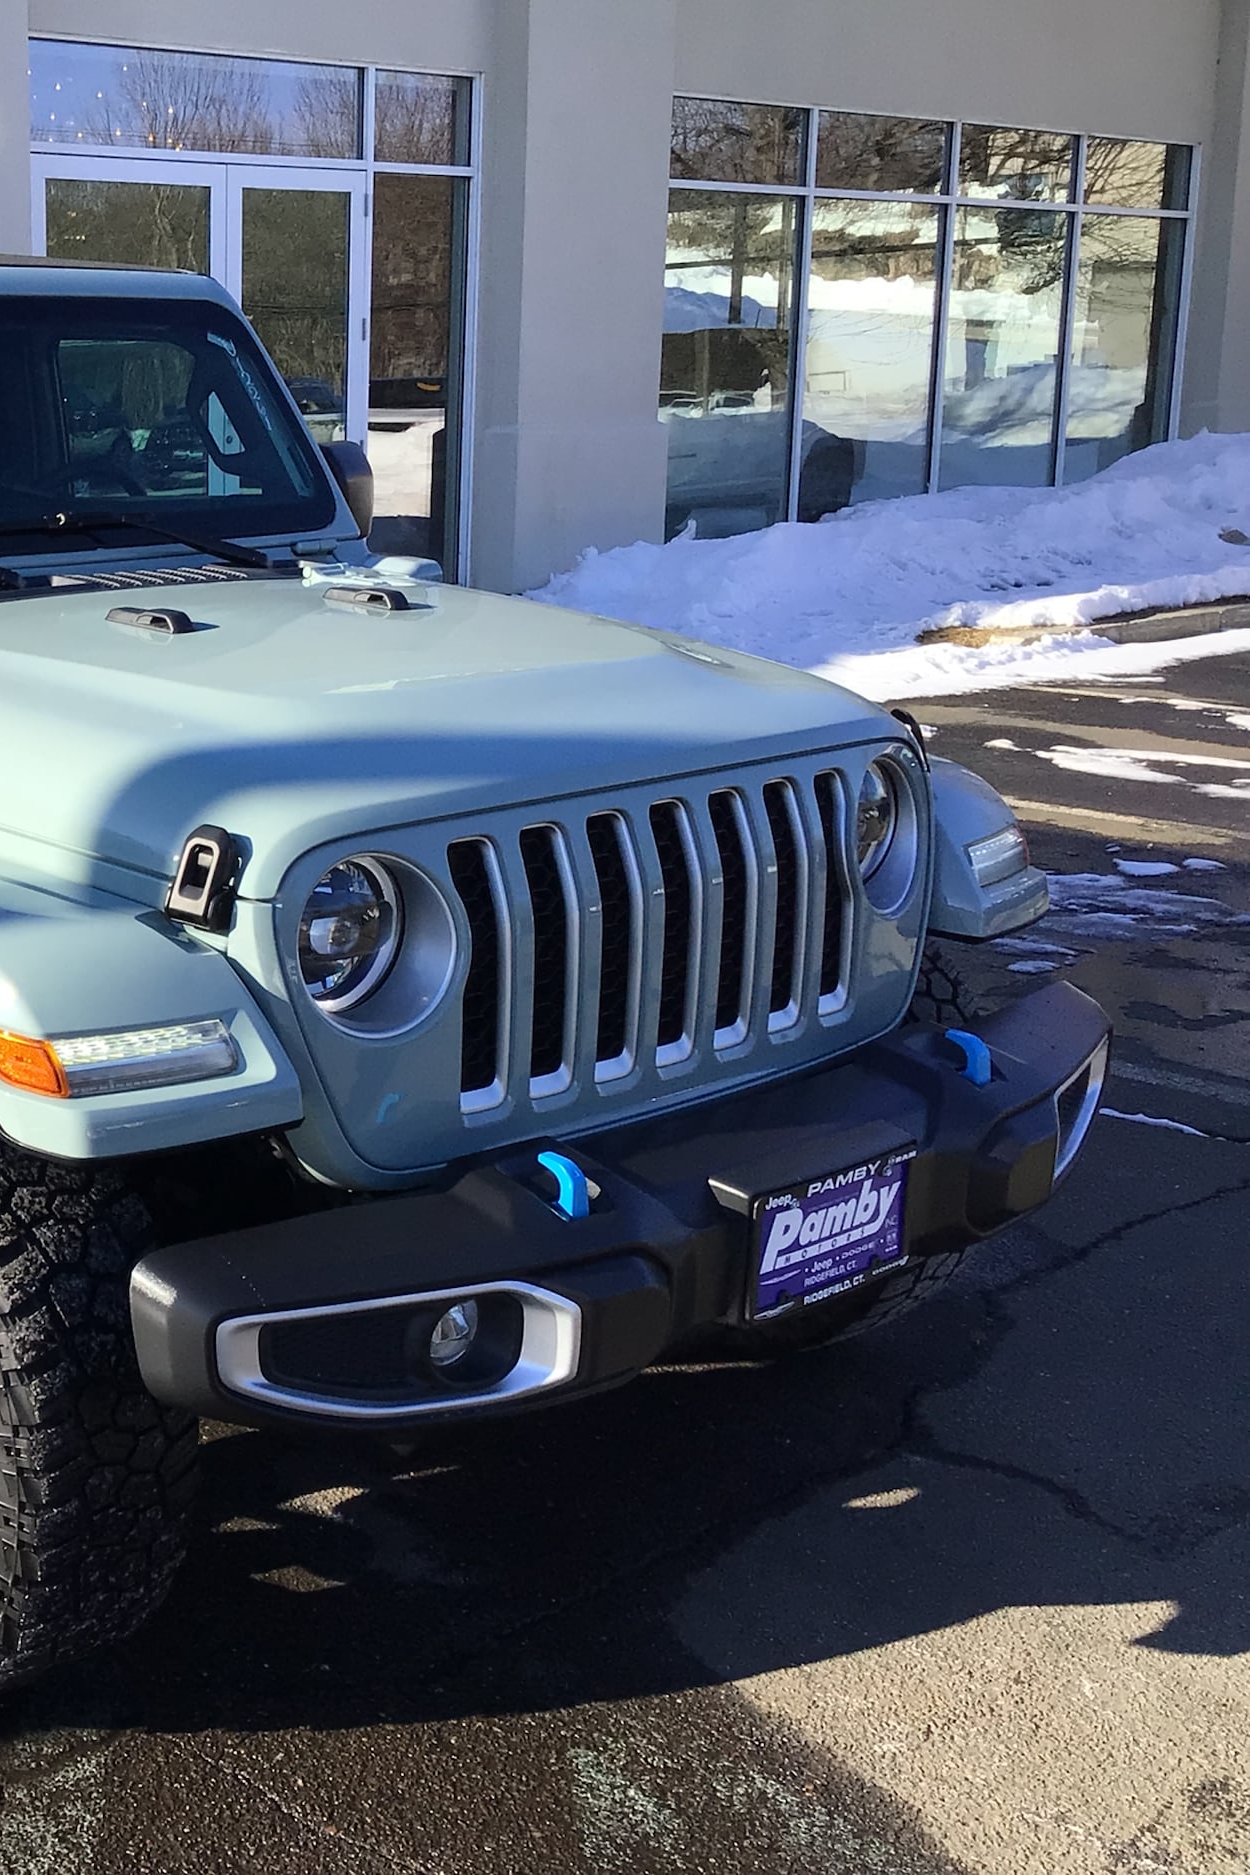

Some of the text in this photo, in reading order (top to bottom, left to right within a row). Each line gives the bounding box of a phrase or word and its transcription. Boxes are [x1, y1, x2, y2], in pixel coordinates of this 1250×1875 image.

[807, 1160, 881, 1198] PAMBY
[759, 1178, 902, 1275] Pamby
[810, 1258, 833, 1274] Jeep
